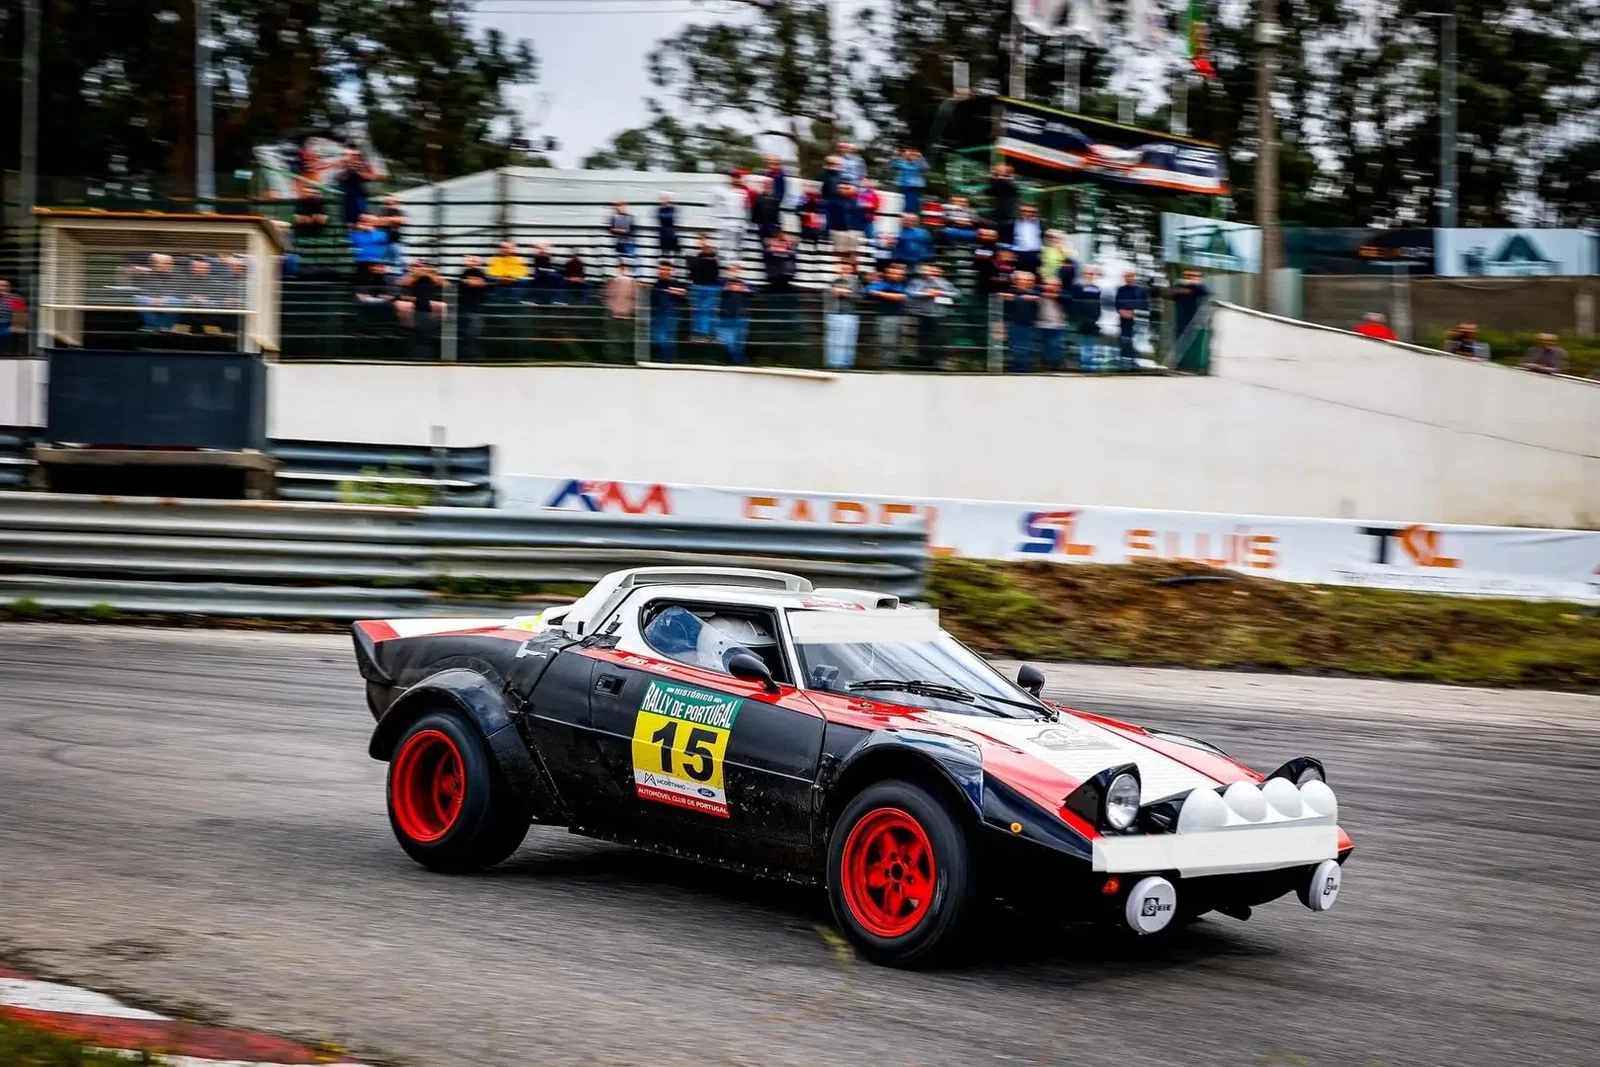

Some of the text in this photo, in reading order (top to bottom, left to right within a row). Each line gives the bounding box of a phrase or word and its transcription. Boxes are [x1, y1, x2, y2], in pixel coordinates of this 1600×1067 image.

[642, 683, 738, 728] RALLY DE PORTUGAL
[674, 688, 713, 702] HISTÓRICO
[652, 721, 718, 782] 15
[638, 787, 728, 814] AUTOMÓVEL CLUB DE PORTUGAL
